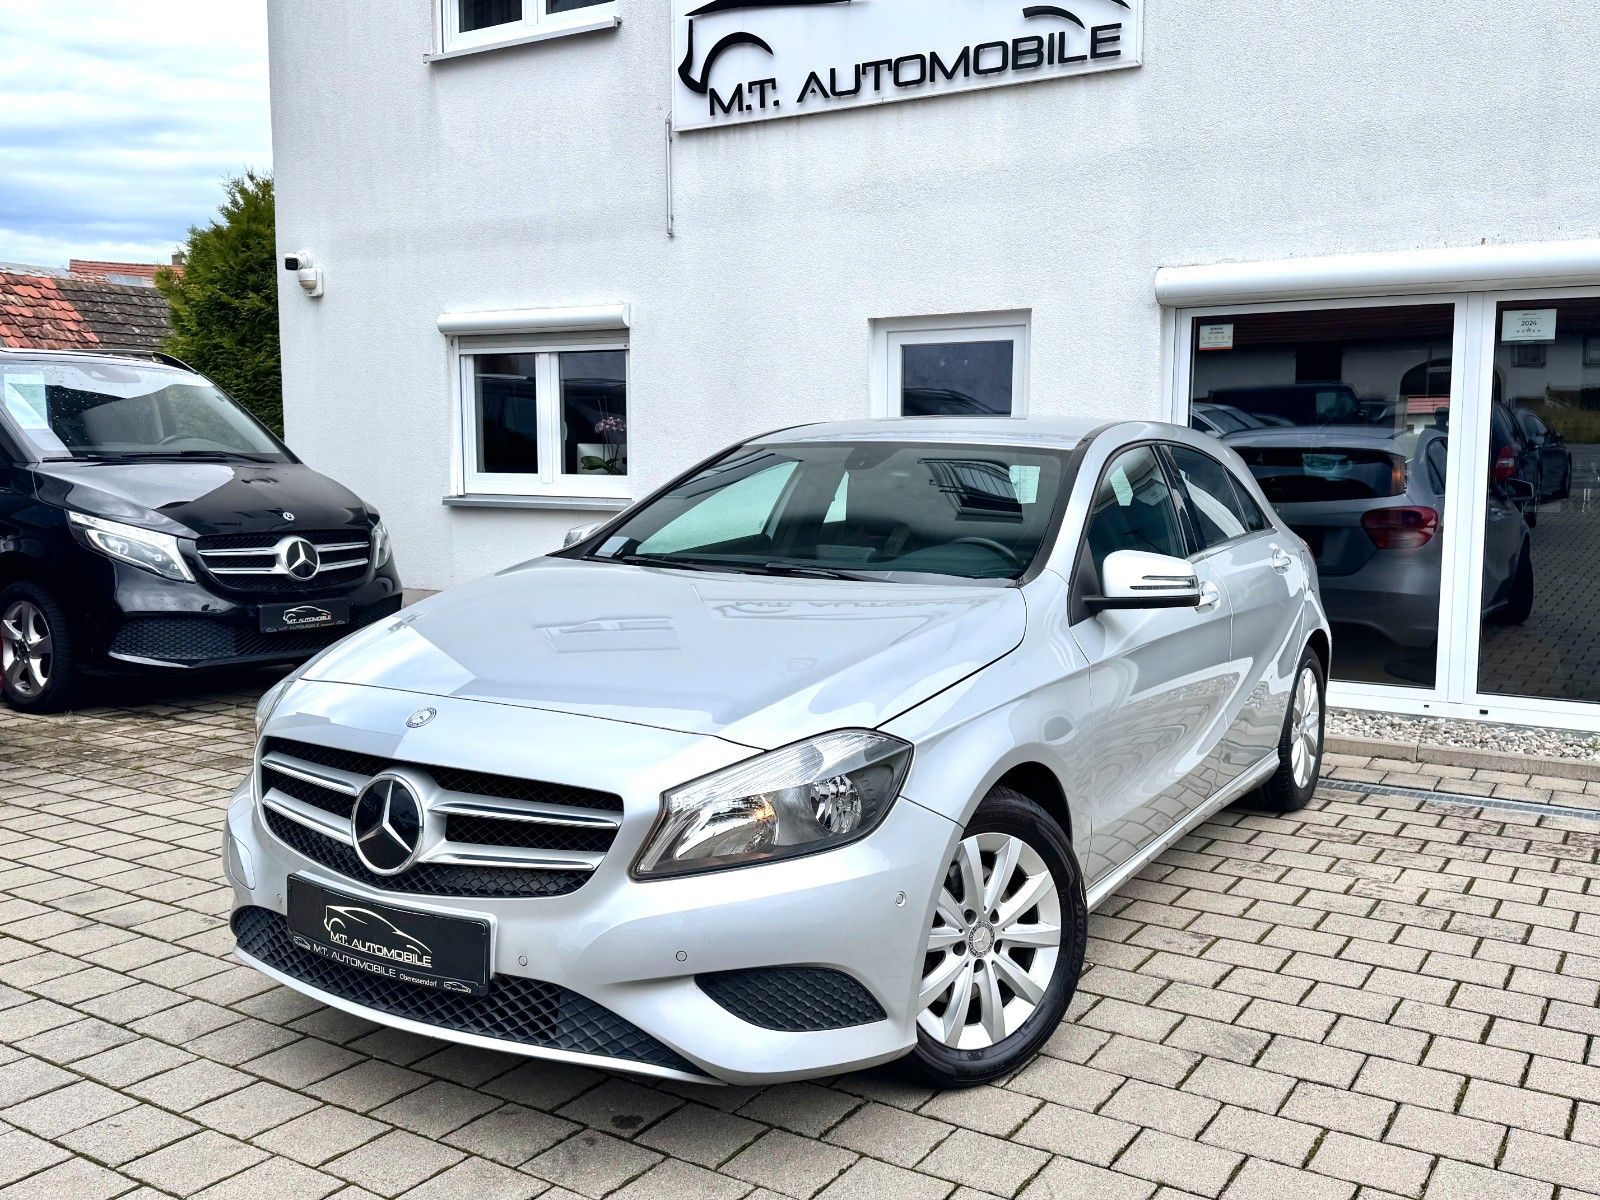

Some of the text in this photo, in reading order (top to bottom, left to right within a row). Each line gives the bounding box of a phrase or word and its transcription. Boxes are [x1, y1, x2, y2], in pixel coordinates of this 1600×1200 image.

[708, 22, 1123, 117] M.T. AUTOMOBILE
[298, 615, 332, 623] AUTOMOBILE
[330, 931, 349, 946] M.T.
[351, 938, 433, 966] AUTOMOBILE
[331, 951, 397, 978] AUTOMOBILE
